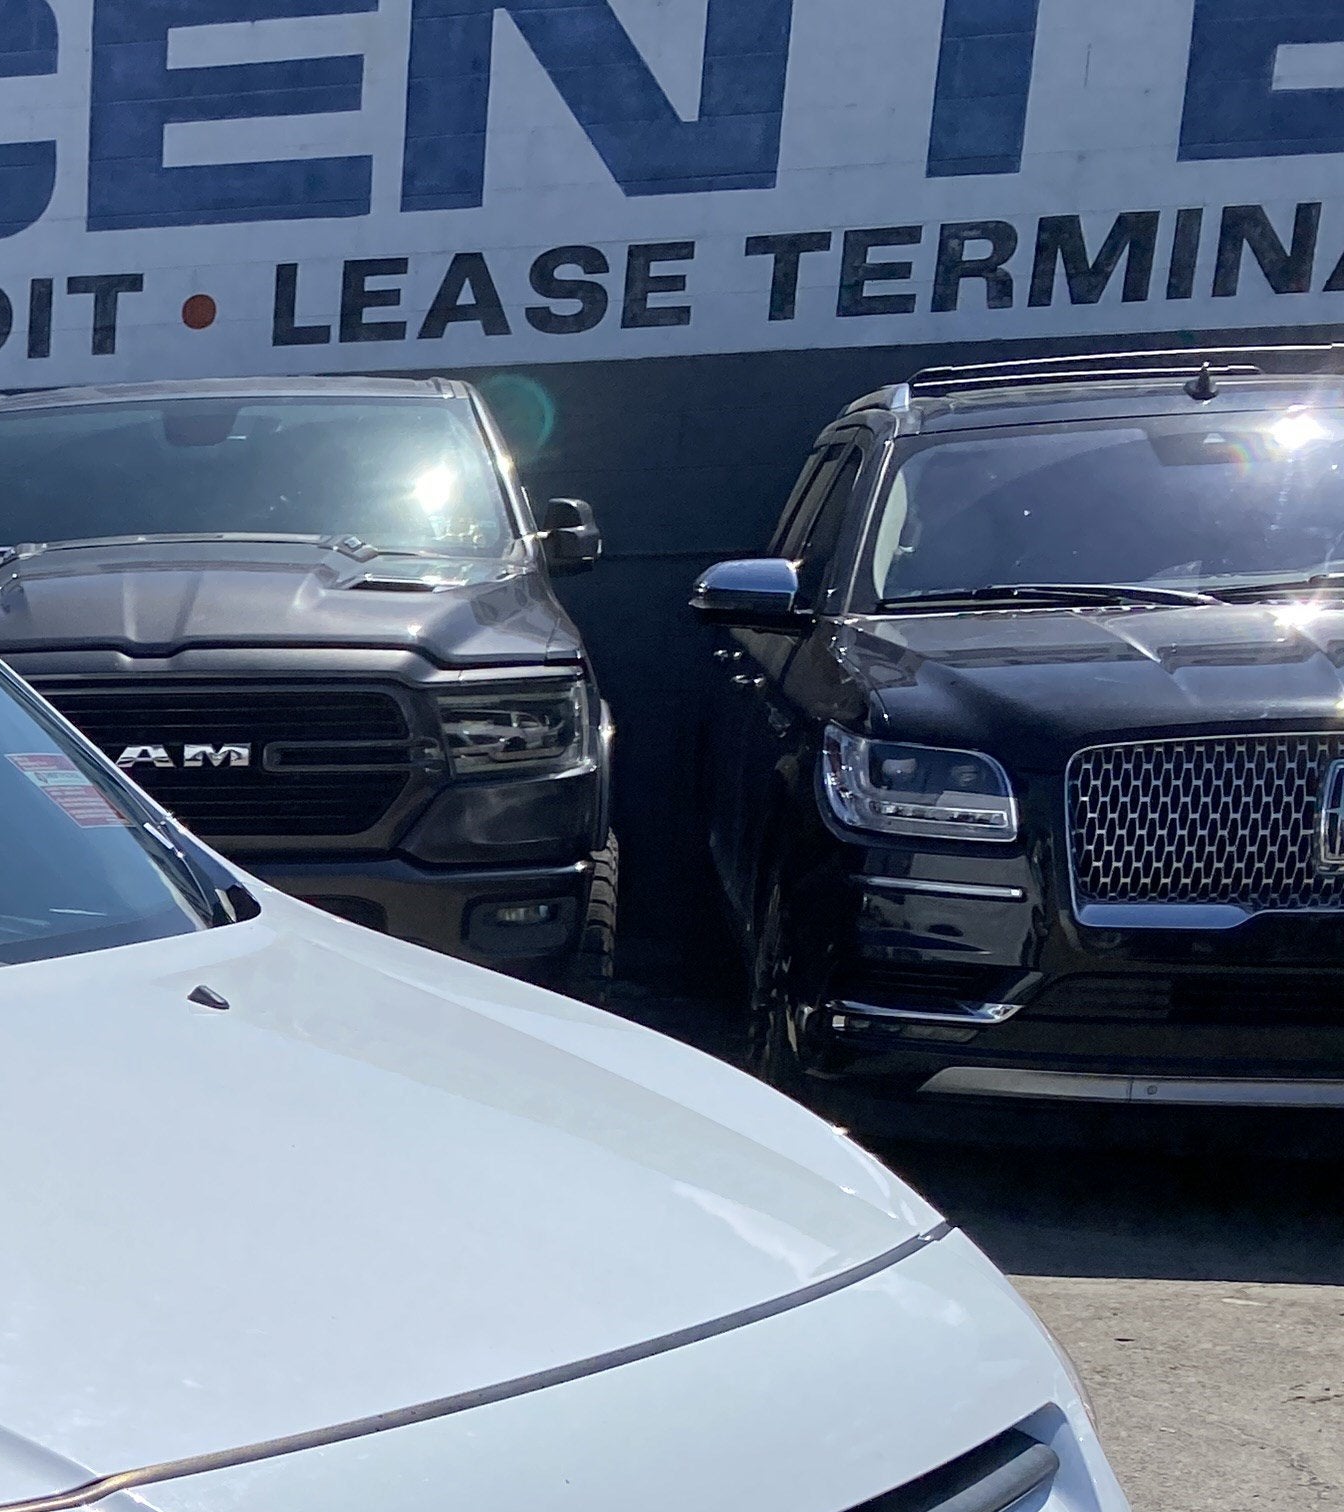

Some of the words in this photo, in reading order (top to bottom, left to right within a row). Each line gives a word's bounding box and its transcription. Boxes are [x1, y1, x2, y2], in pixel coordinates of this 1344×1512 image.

[272, 241, 696, 348] LEASE
[745, 202, 1344, 322] TERMIN
[115, 742, 252, 768] AM
